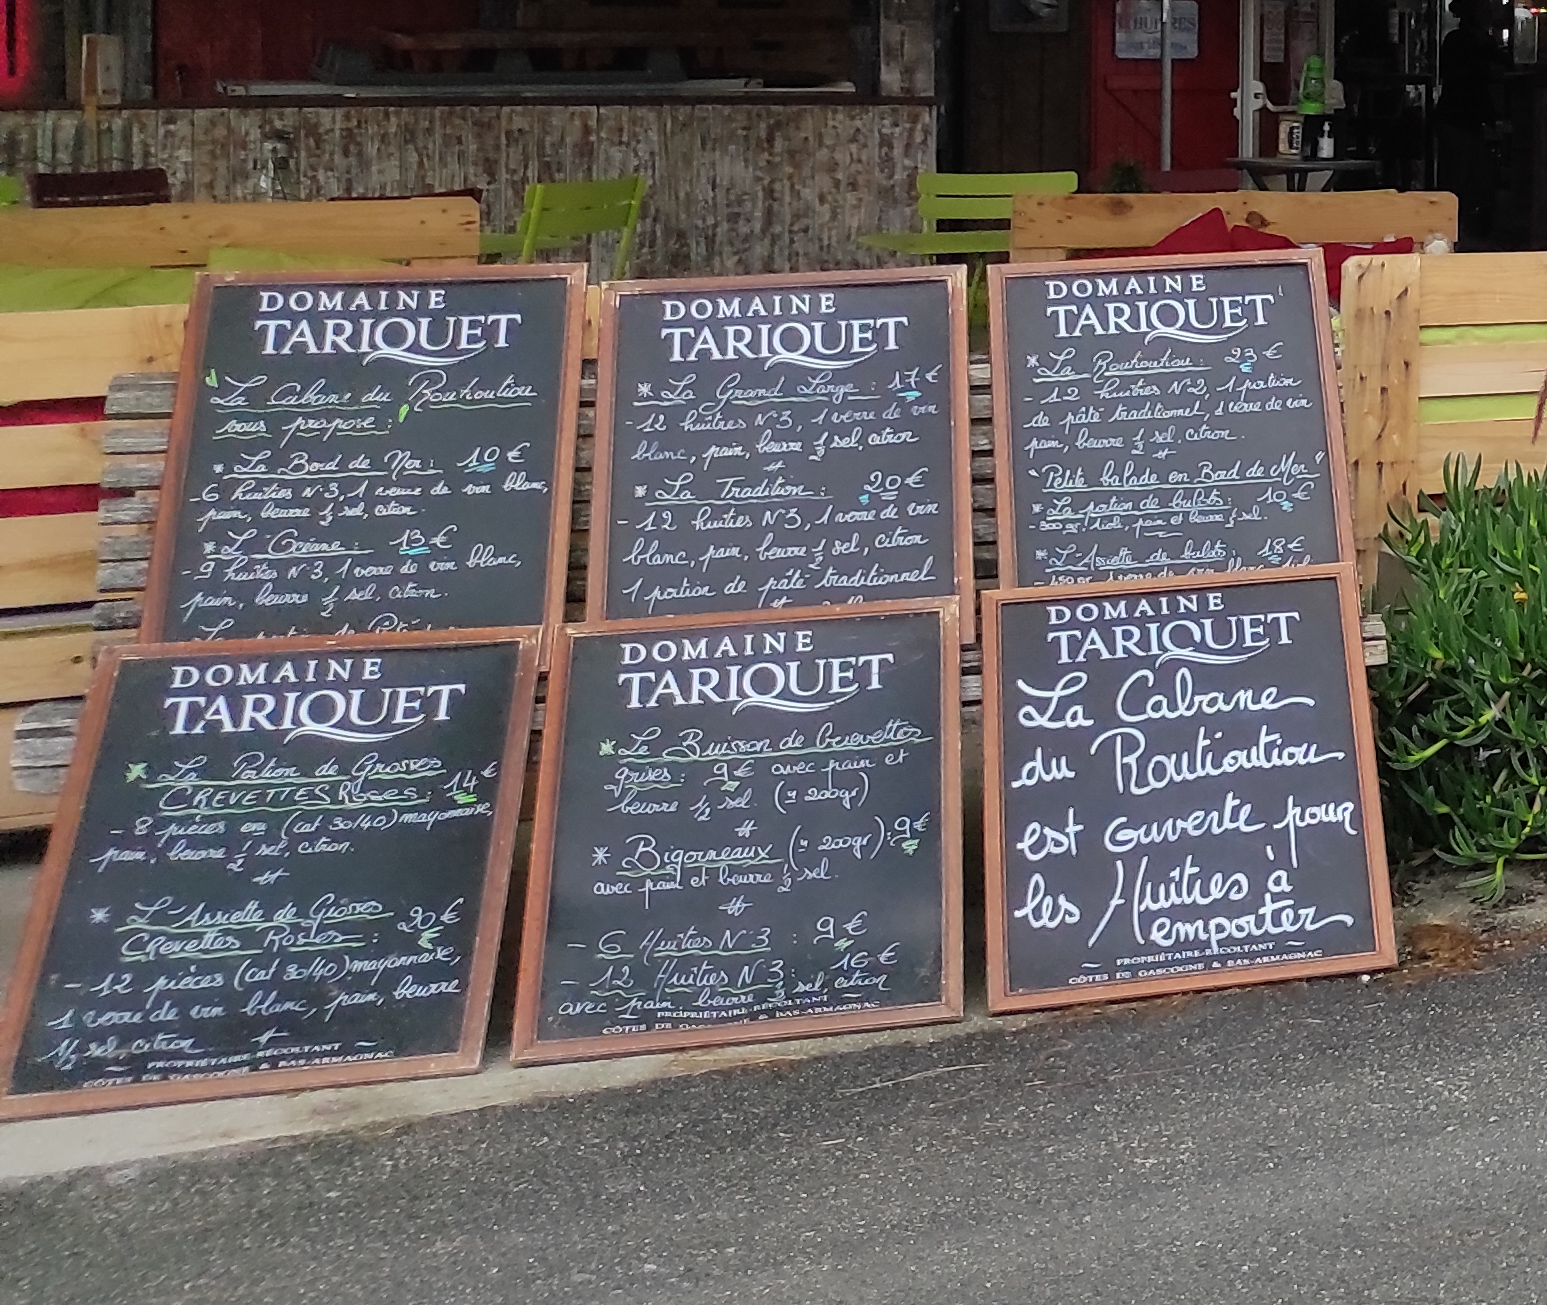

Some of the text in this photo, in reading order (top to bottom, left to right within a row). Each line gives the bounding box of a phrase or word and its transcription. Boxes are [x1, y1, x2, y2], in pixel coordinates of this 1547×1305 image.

[259, 289, 447, 313] DOMAINE
[661, 293, 837, 321] DOMAINE
[1044, 273, 1206, 300] DOMAINE
[254, 314, 522, 366] TARIQUET
[1046, 294, 1275, 345] TARIQUET
[660, 316, 909, 370] TARIQUET
[1224, 342, 1284, 364] 23 €
[888, 368, 920, 391] 17
[925, 364, 943, 384] €
[863, 473, 902, 495] 20
[904, 468, 929, 489] €
[1257, 481, 1315, 504] 10 €
[1046, 592, 1225, 626] DOMAINE
[618, 629, 814, 666] DOMAINE
[1046, 610, 1301, 670] TARIQUET
[170, 657, 383, 689] DOMAINE
[617, 653, 895, 715] TARIQUET
[162, 683, 466, 744] TARIQUET
[1016, 666, 1317, 729] La Cabane
[158, 760, 498, 811] CREVETTES 14 €
[1010, 745, 1077, 790] du
[1016, 806, 1085, 862] est
[1272, 794, 1359, 869] pour
[1013, 872, 1082, 930] les
[1265, 844, 1295, 895] à
[843, 910, 868, 935] €
[1149, 892, 1355, 952] emporter
